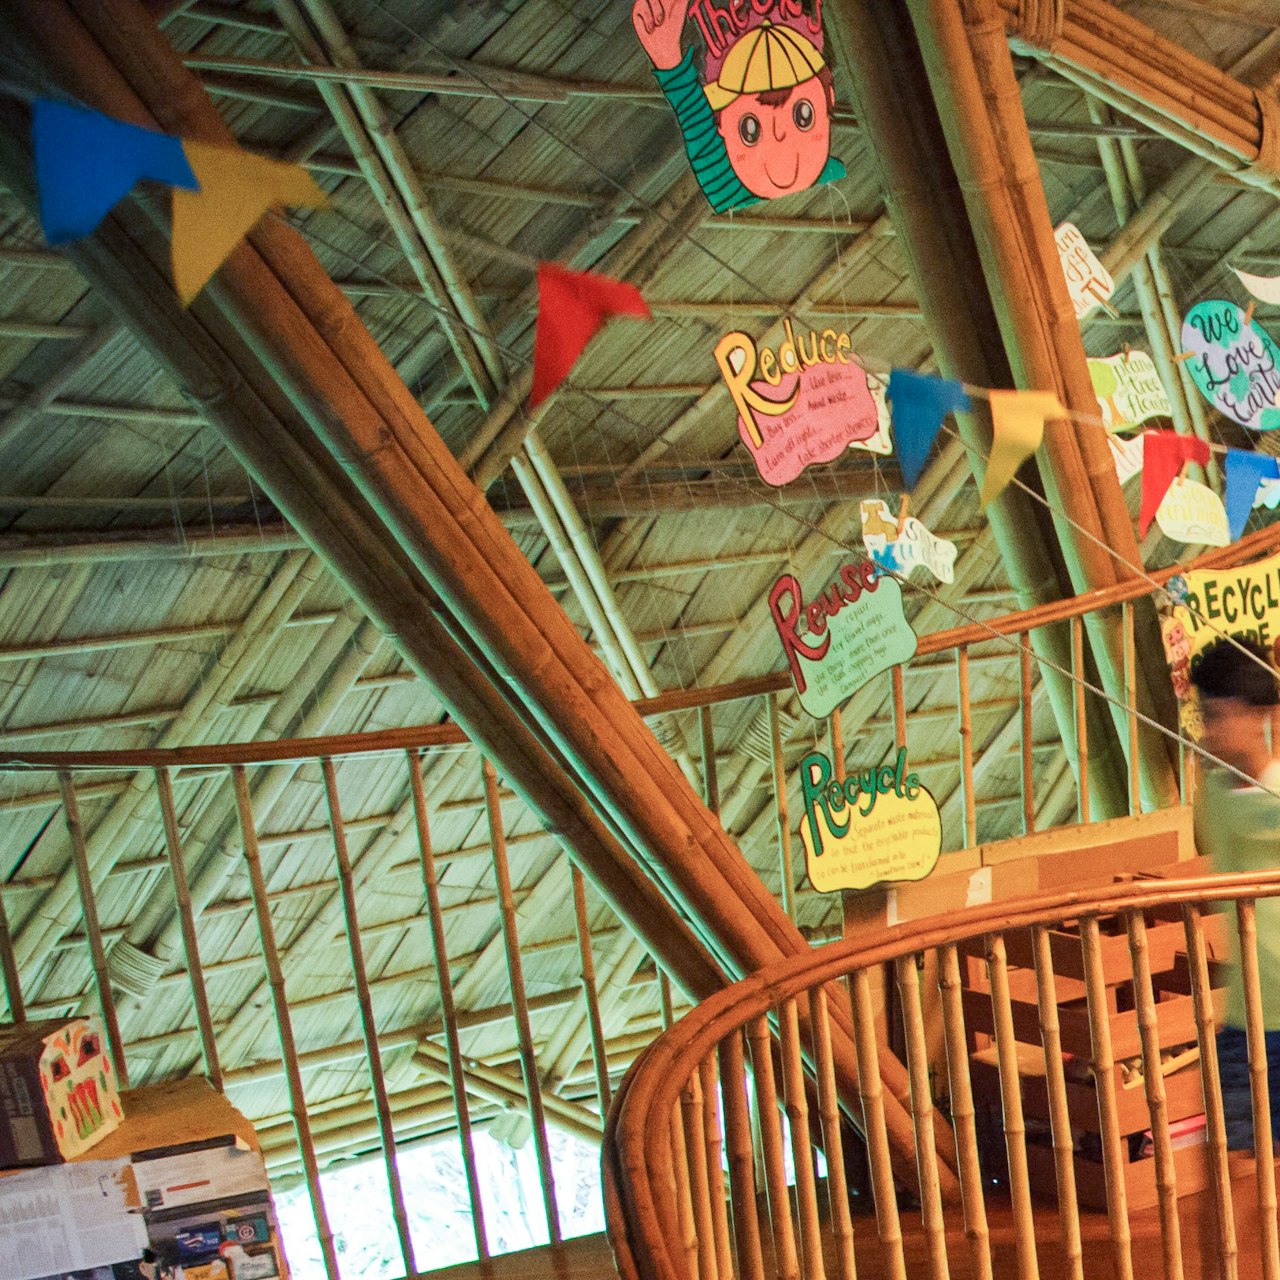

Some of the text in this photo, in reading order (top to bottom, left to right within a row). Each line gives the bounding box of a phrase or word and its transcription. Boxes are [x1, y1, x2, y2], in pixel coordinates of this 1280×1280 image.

[1191, 308, 1239, 343] We
[1195, 341, 1265, 391] Love
[713, 317, 851, 449] Reduce
[768, 561, 879, 695] Reuse
[801, 746, 920, 857] Recycle
